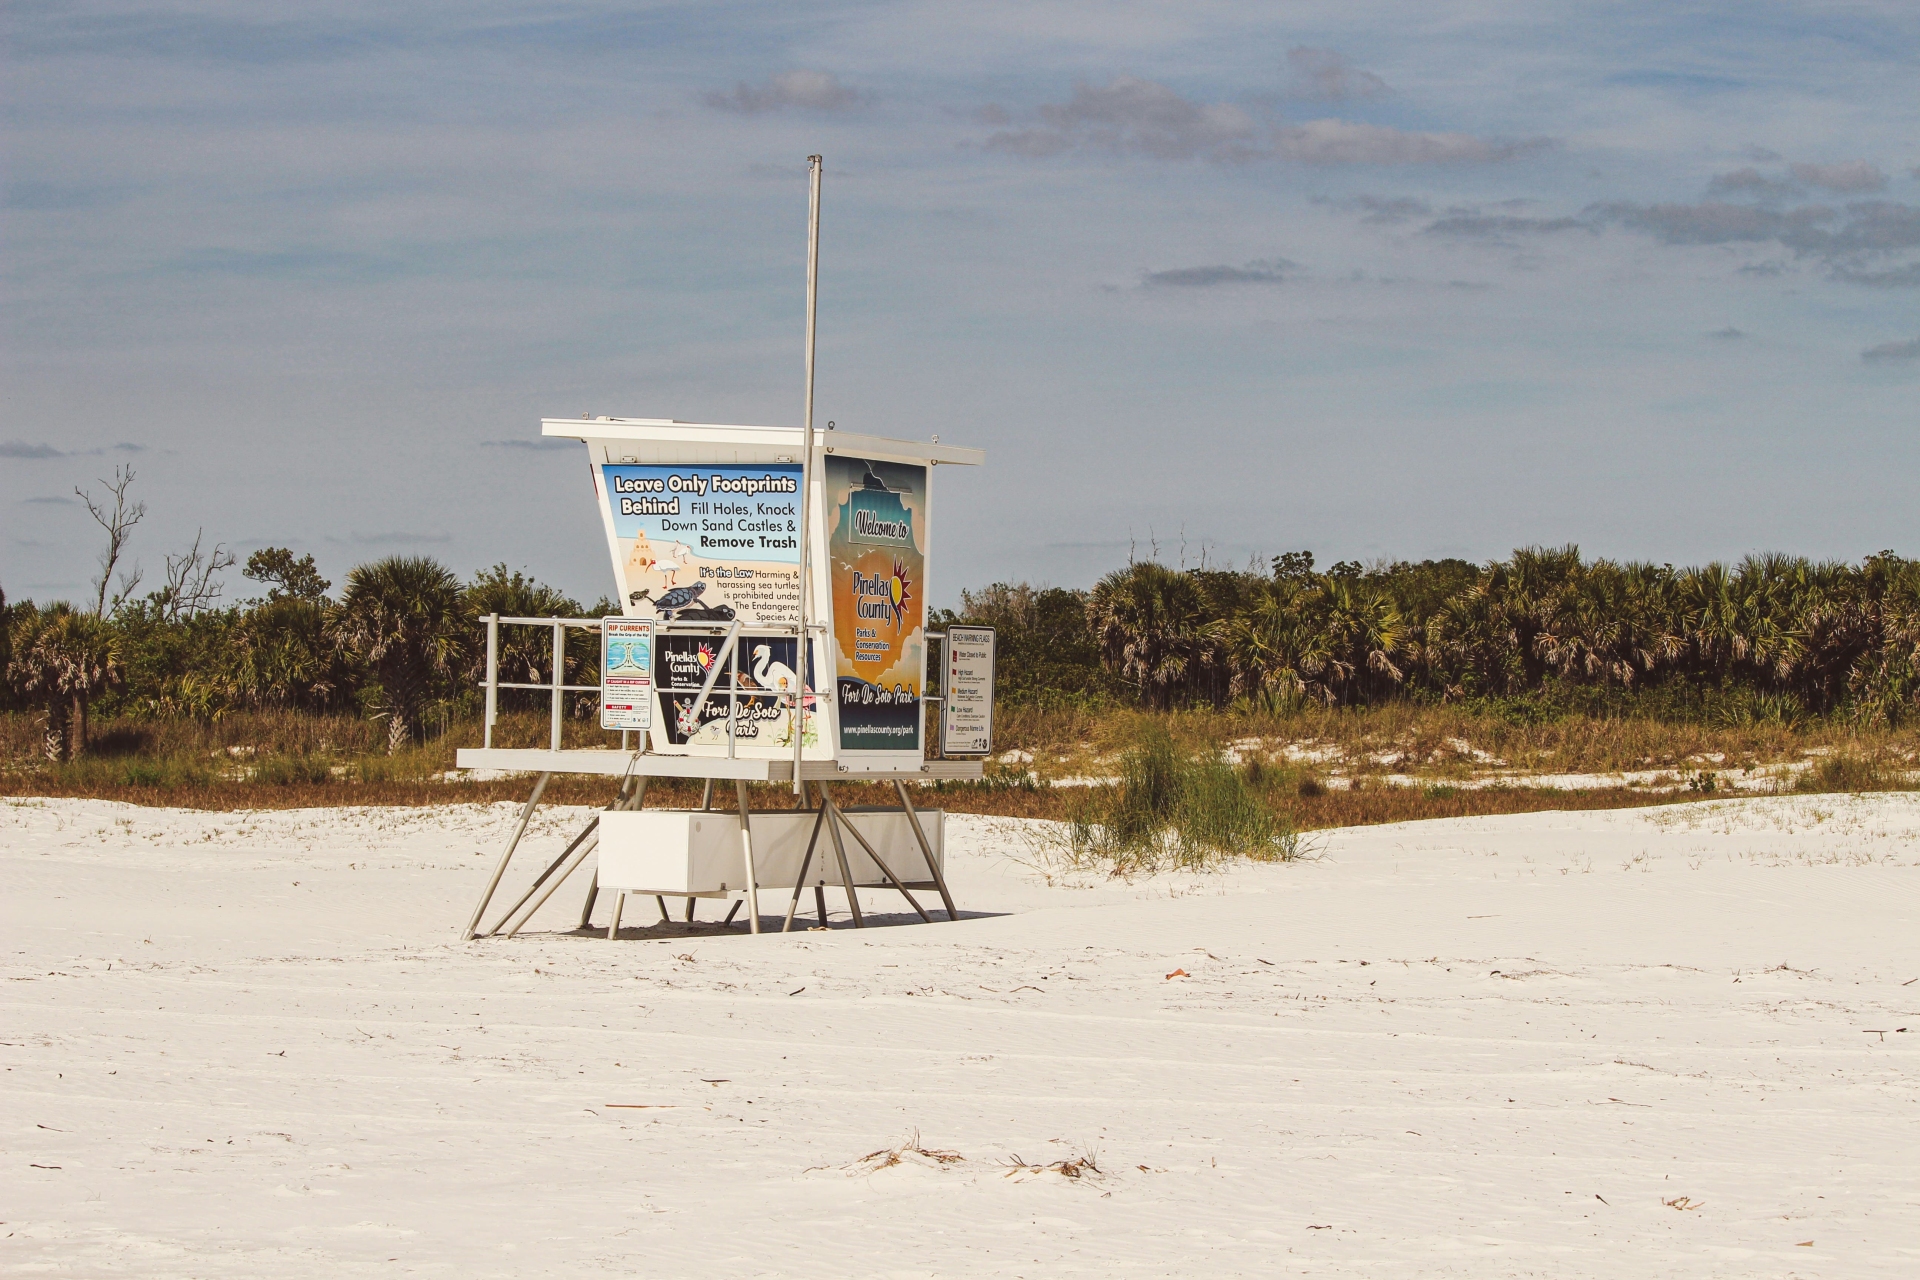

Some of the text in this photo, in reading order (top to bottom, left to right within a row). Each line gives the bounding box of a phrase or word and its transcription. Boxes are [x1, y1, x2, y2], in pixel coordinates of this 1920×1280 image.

[614, 474, 797, 496] Leave Only Footprints
[621, 497, 680, 515] Behind
[691, 502, 795, 517] Fill Holes, Knock
[661, 519, 796, 532] Down Sand Castles &
[854, 509, 909, 540] Welcome to
[700, 535, 797, 548] Remove Trash
[699, 566, 799, 580] It's the Law Harming &
[717, 580, 756, 590] harassing
[774, 580, 799, 590] turtles
[852, 570, 889, 596] Pinellas
[723, 591, 731, 599] is
[732, 591, 774, 600] prohibited
[734, 601, 750, 610] The
[857, 595, 891, 627] County
[755, 613, 799, 622] Species Ac
[856, 627, 877, 638] Parks &
[953, 633, 990, 643] BEACH WARNING FLAGS
[855, 640, 890, 651] Conservation
[664, 650, 698, 663] Pinellas
[855, 651, 881, 661] Resources
[670, 661, 700, 677] County
[842, 683, 914, 706] Fort De Soto Park
[702, 700, 781, 719] Fort De Soto
[843, 724, 914, 737] www.pinellascounty.org/park
